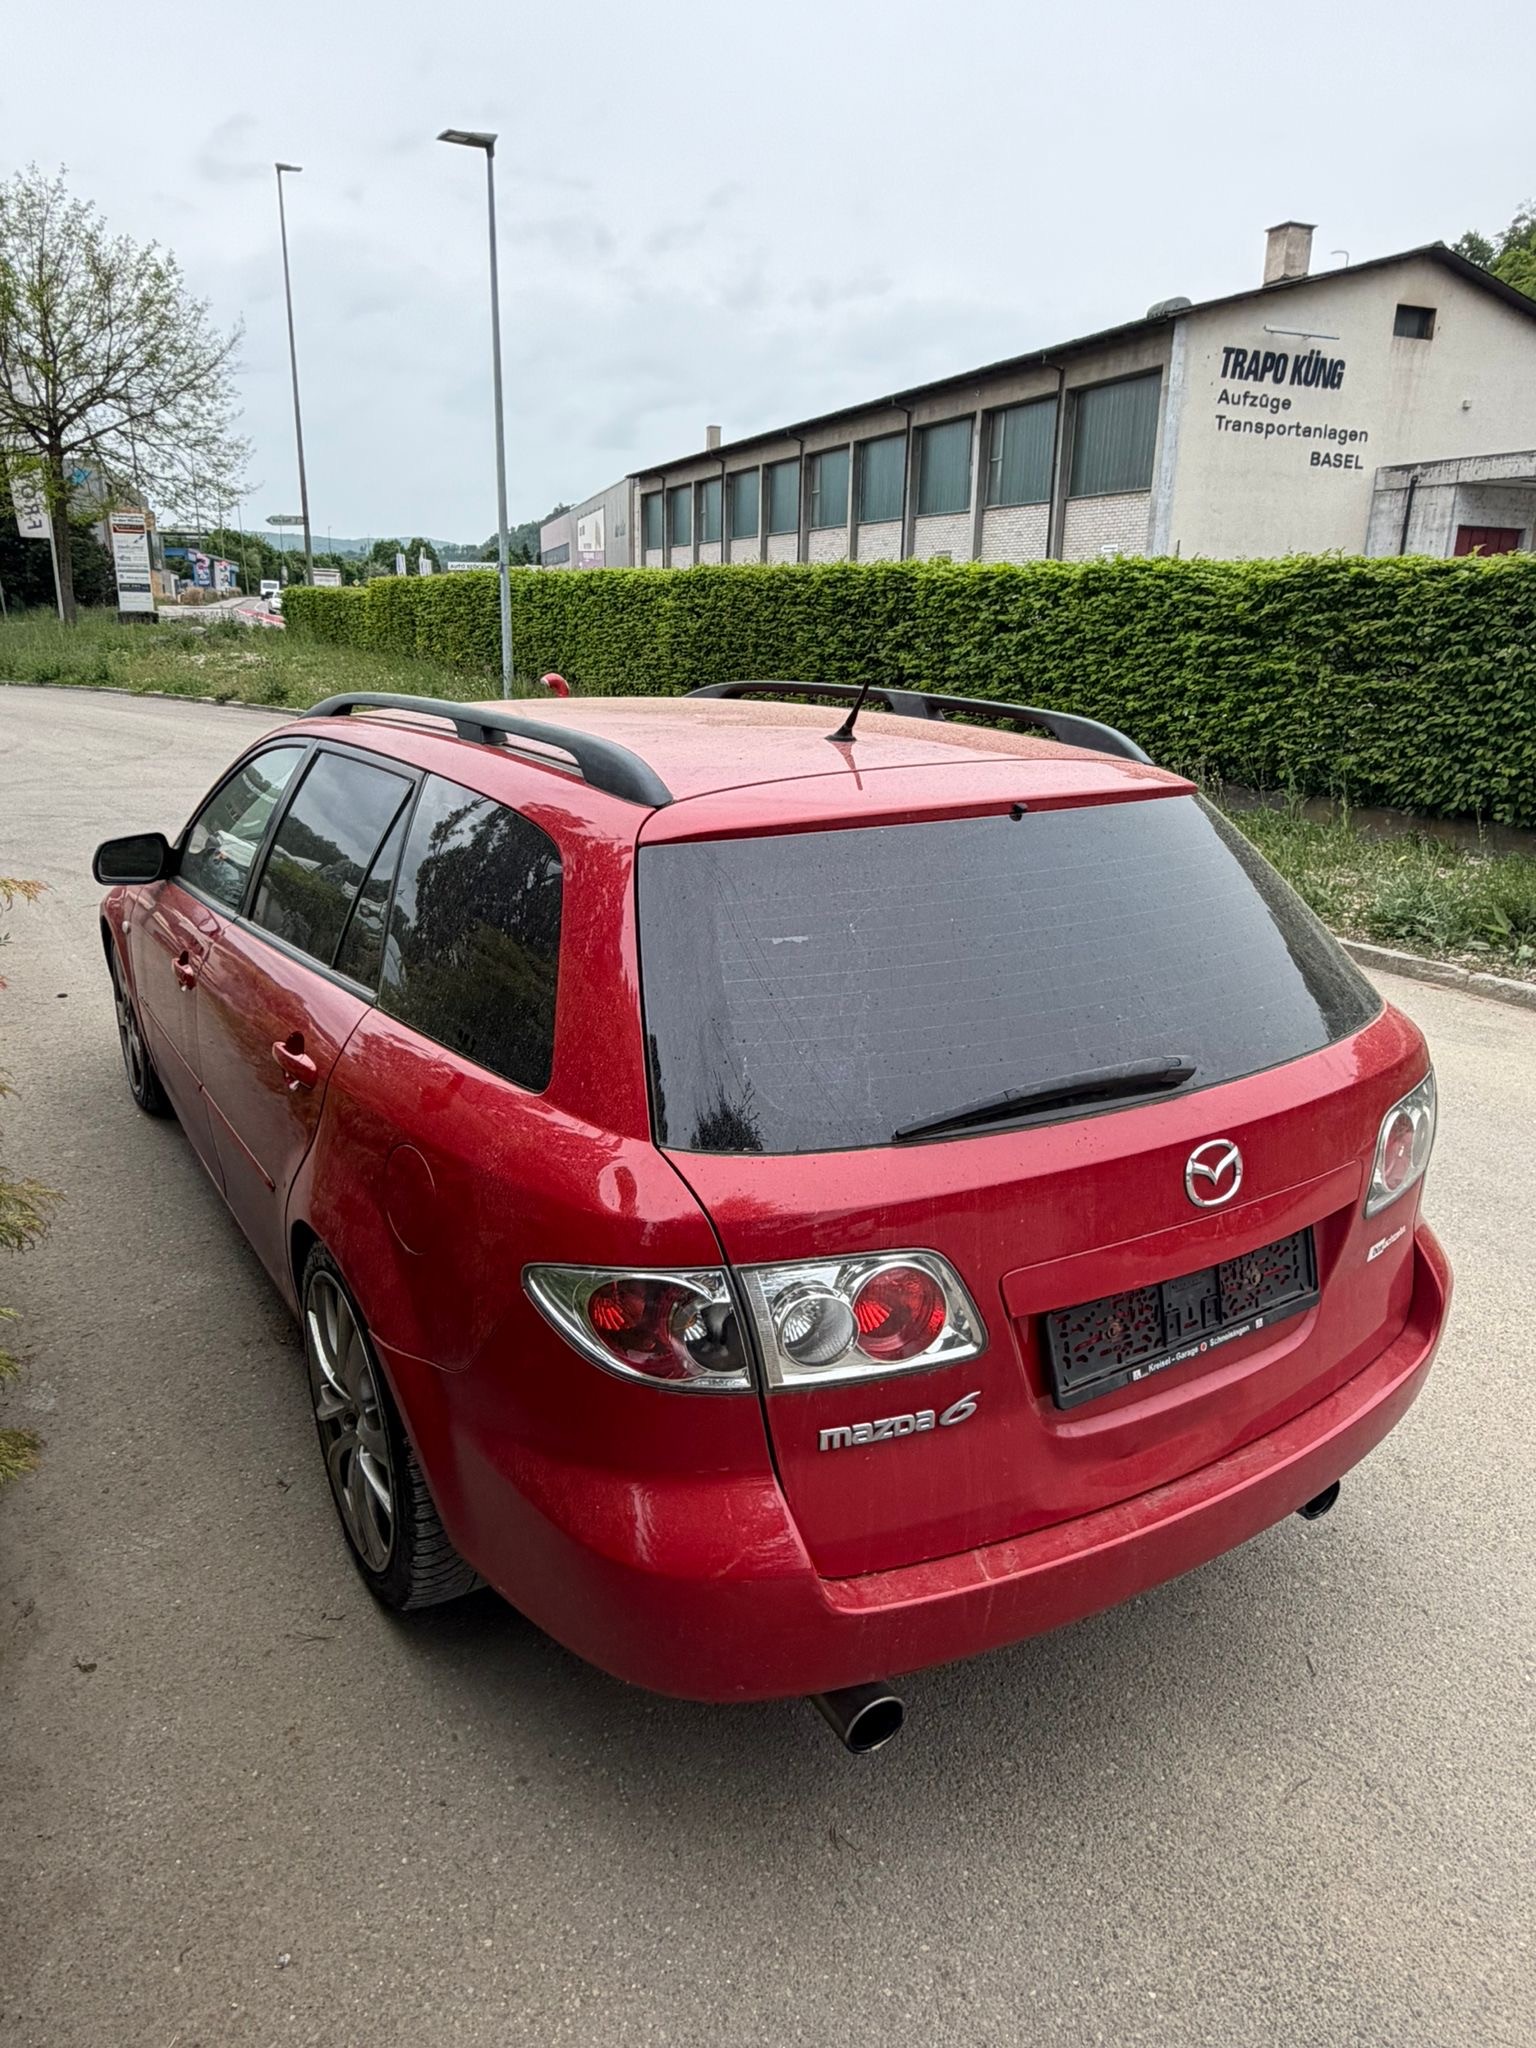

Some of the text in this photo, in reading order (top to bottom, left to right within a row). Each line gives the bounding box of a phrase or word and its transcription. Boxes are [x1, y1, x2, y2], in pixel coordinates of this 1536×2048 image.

[1220, 346, 1346, 390] TRAPO KÜNG
[1217, 389, 1292, 414] Aufzüge
[1215, 415, 1369, 445] Transportanlagen
[1310, 451, 1364, 470] BASEL
[938, 1390, 982, 1427] 6
